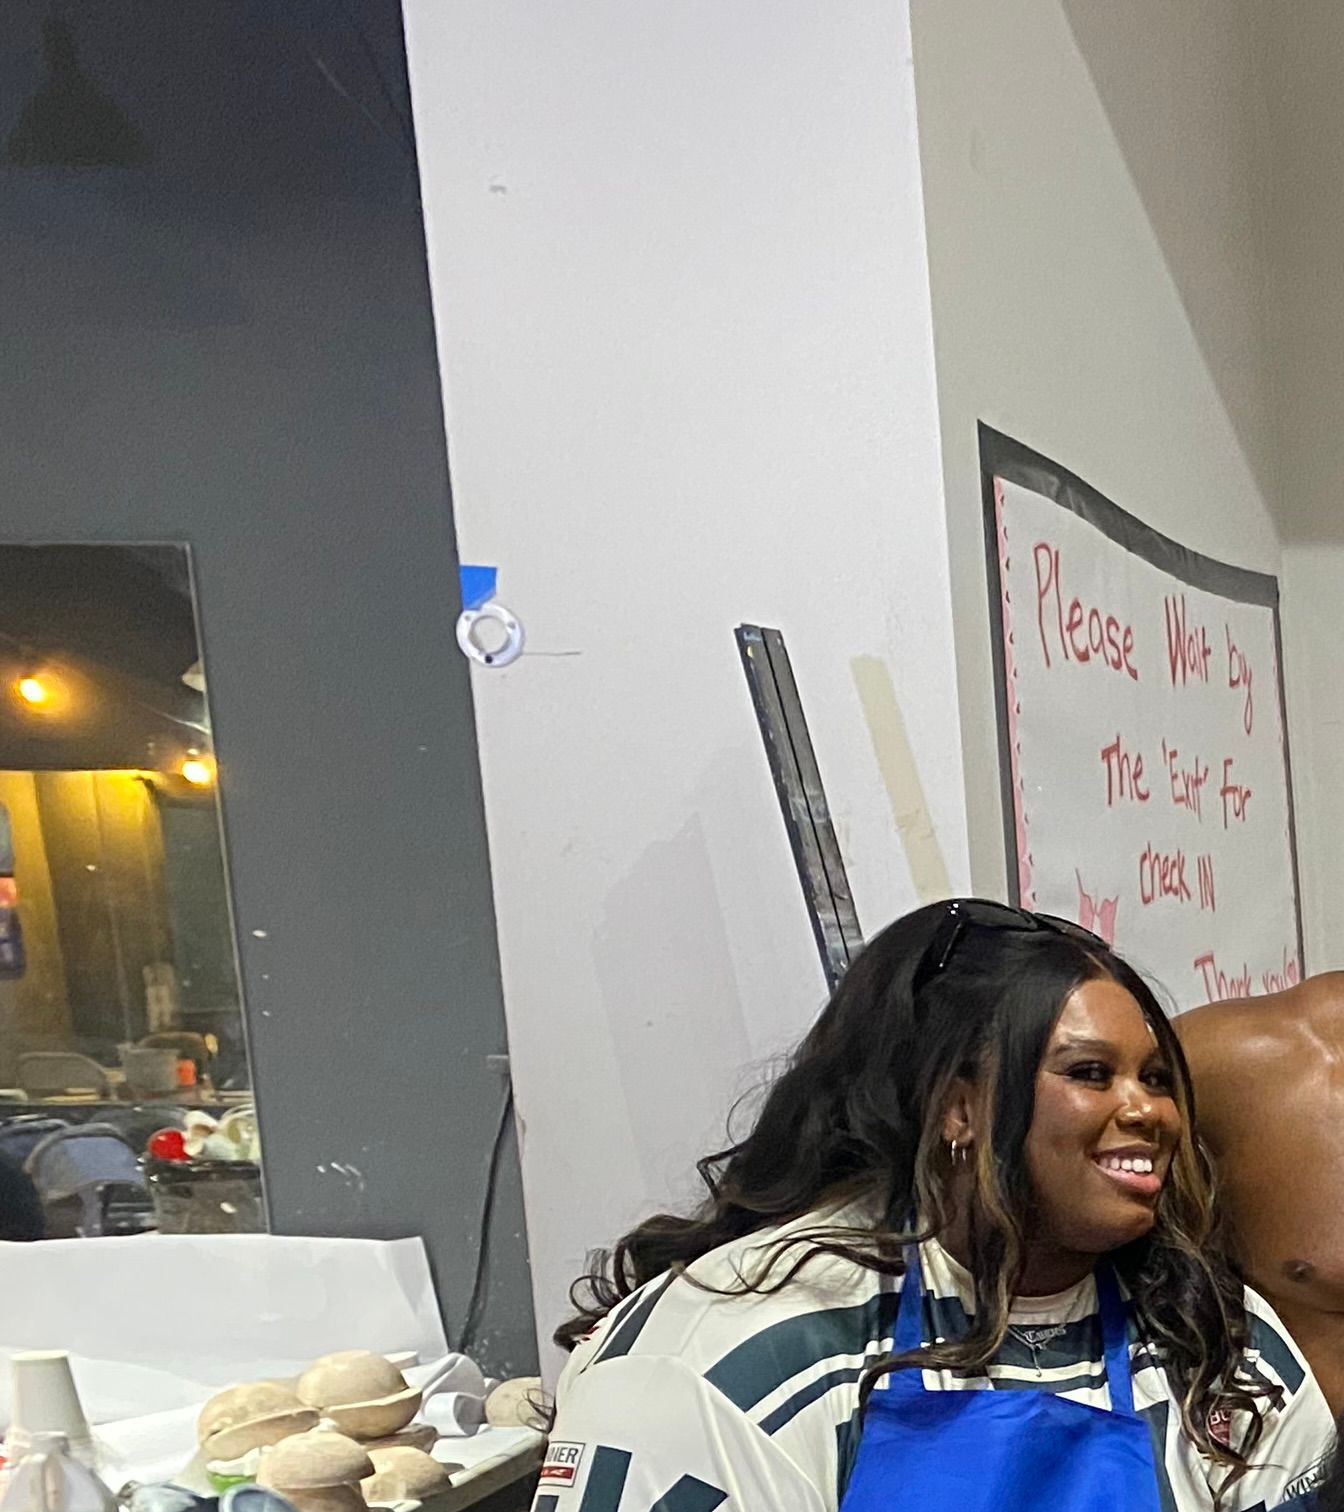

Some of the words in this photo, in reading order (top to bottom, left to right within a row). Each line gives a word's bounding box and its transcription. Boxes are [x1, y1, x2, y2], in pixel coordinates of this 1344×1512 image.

[1034, 542, 1138, 681] Please
[1165, 593, 1212, 687] Wait
[1225, 623, 1253, 736] by
[1101, 732, 1150, 806] The
[1220, 758, 1252, 829] For
[1197, 853, 1215, 912] IN
